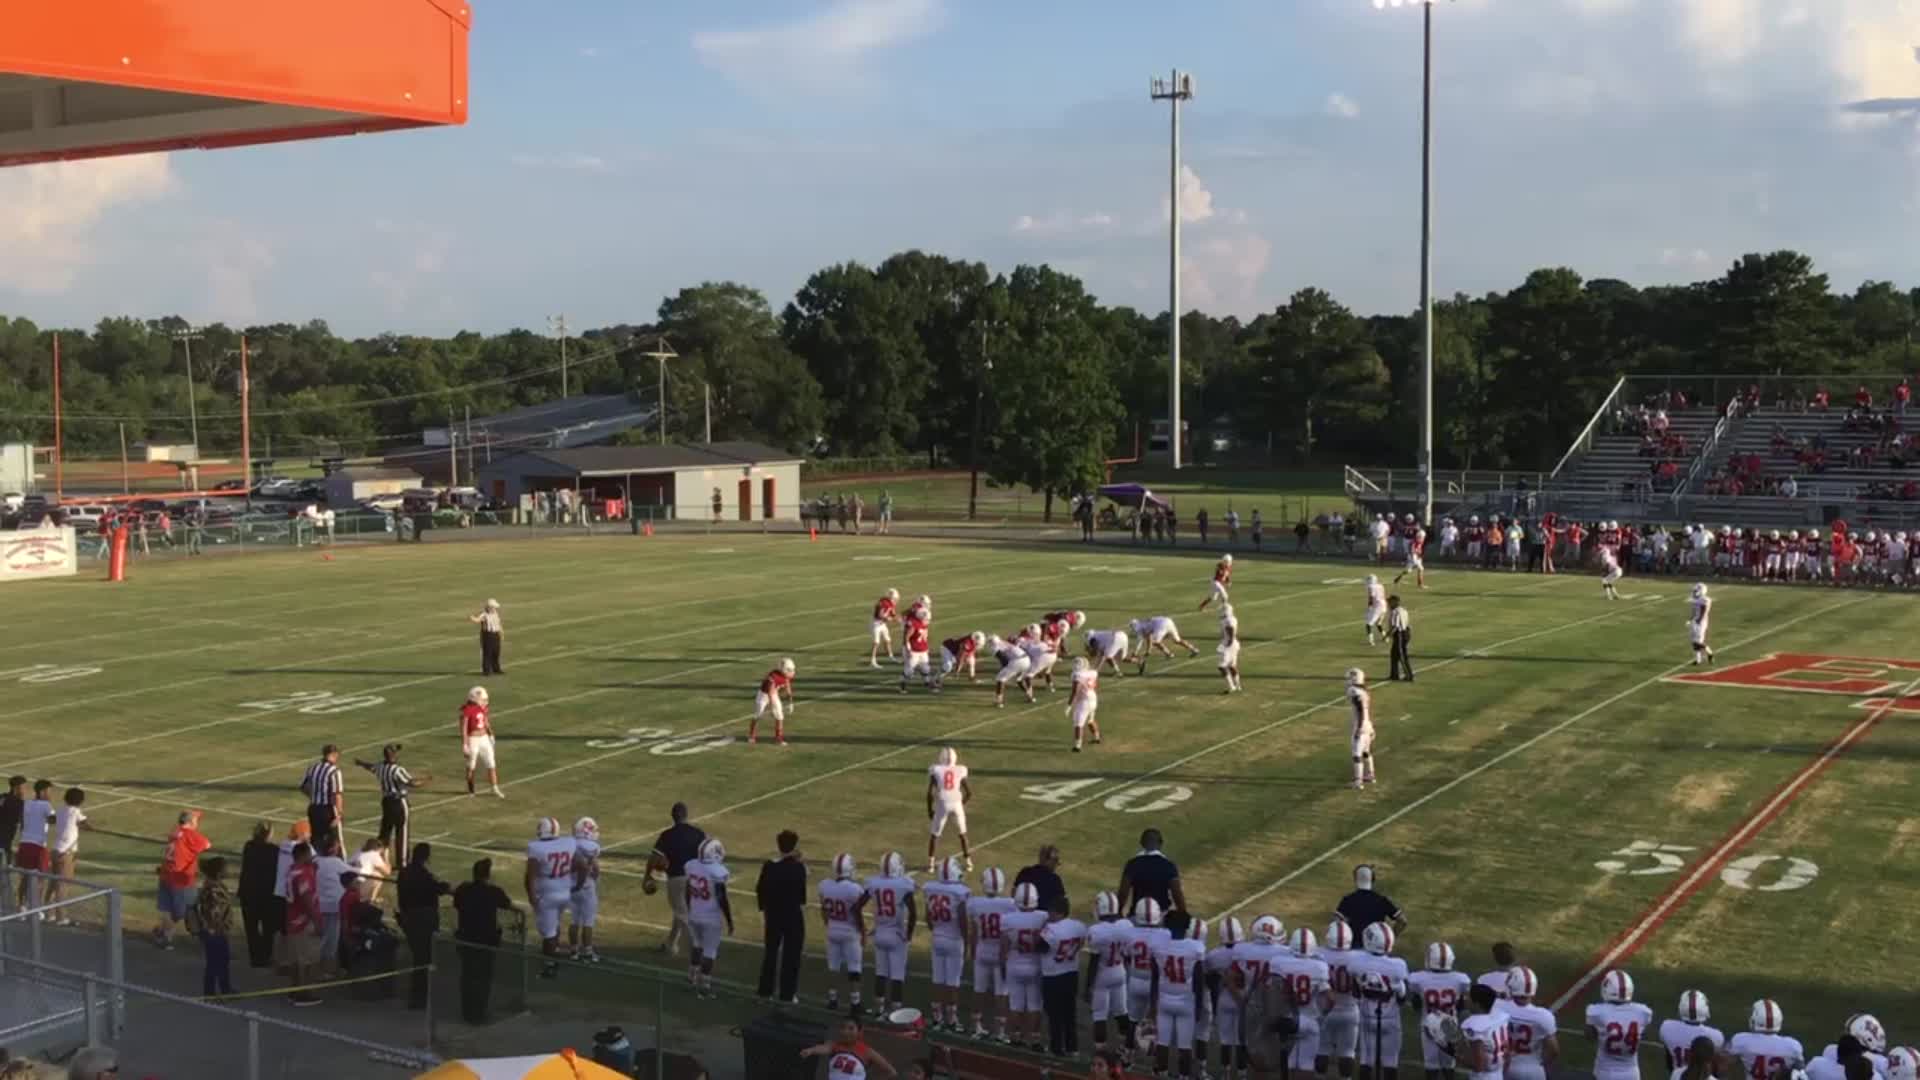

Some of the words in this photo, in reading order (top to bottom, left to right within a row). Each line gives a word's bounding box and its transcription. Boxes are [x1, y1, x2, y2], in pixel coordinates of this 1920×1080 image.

[943, 771, 955, 791] 8
[1019, 777, 1194, 813] 40
[548, 852, 571, 878] 72
[1594, 840, 1819, 891] 50
[874, 888, 897, 918] 19
[1054, 936, 1083, 963] 57
[1163, 954, 1187, 985] 41
[1605, 1021, 1640, 1056] 24
